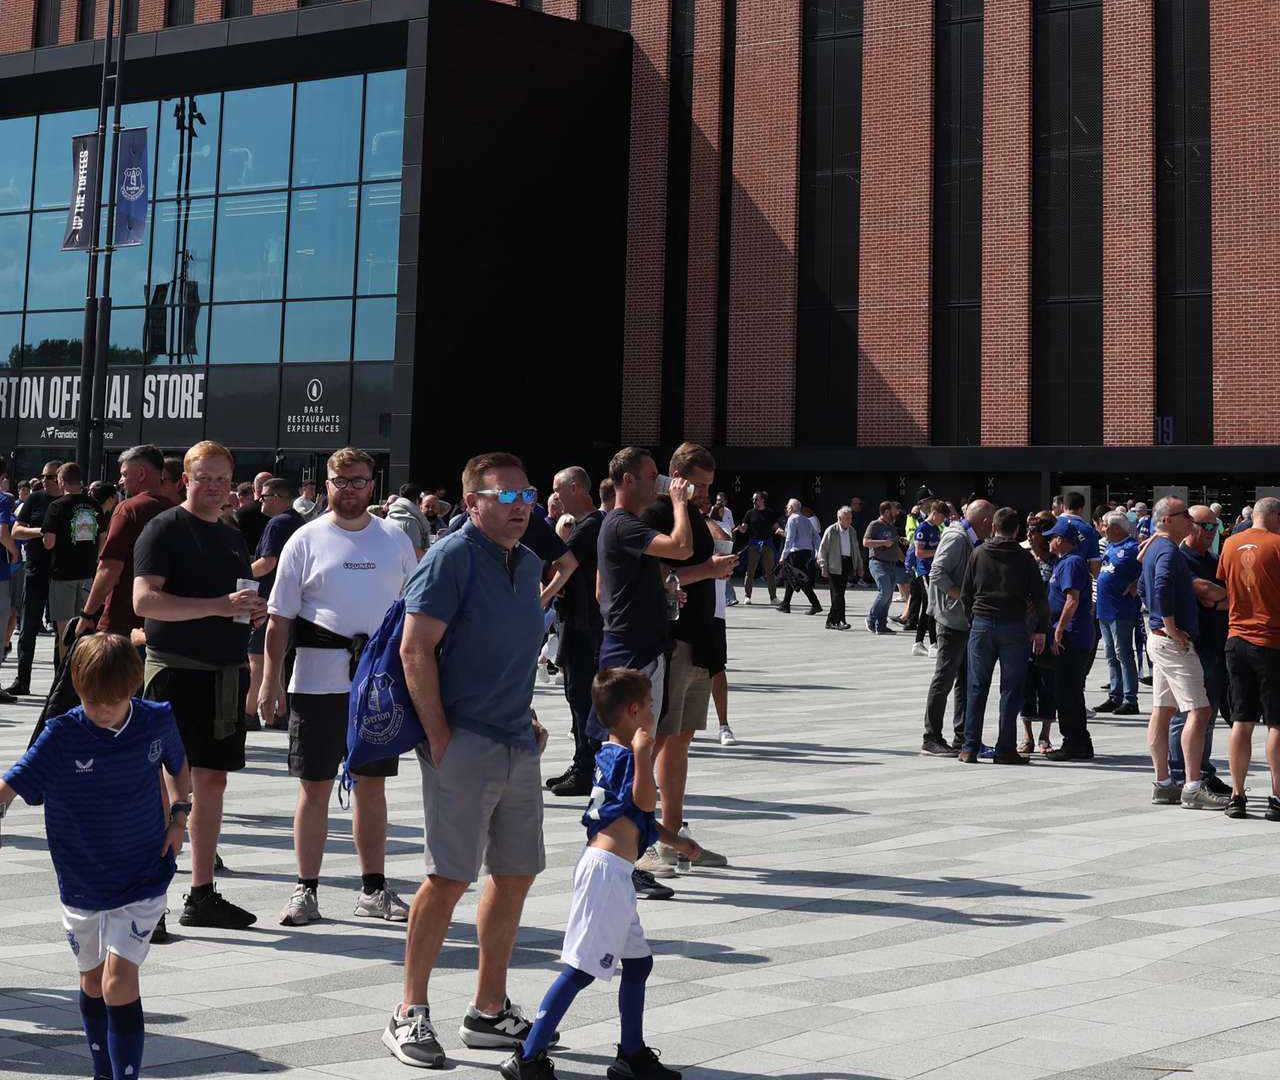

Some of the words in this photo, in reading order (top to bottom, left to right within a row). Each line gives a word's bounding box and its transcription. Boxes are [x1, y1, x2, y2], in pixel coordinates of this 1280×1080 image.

[77, 150, 89, 193] TOFFEES
[75, 194, 86, 215] THE
[72, 215, 83, 230] UP
[48, 374, 132, 419] OFFAL
[142, 373, 205, 419] STORE
[303, 406, 324, 414] BARS
[287, 415, 340, 423] RESTAURANTS
[287, 424, 340, 433] EXPERIENCES
